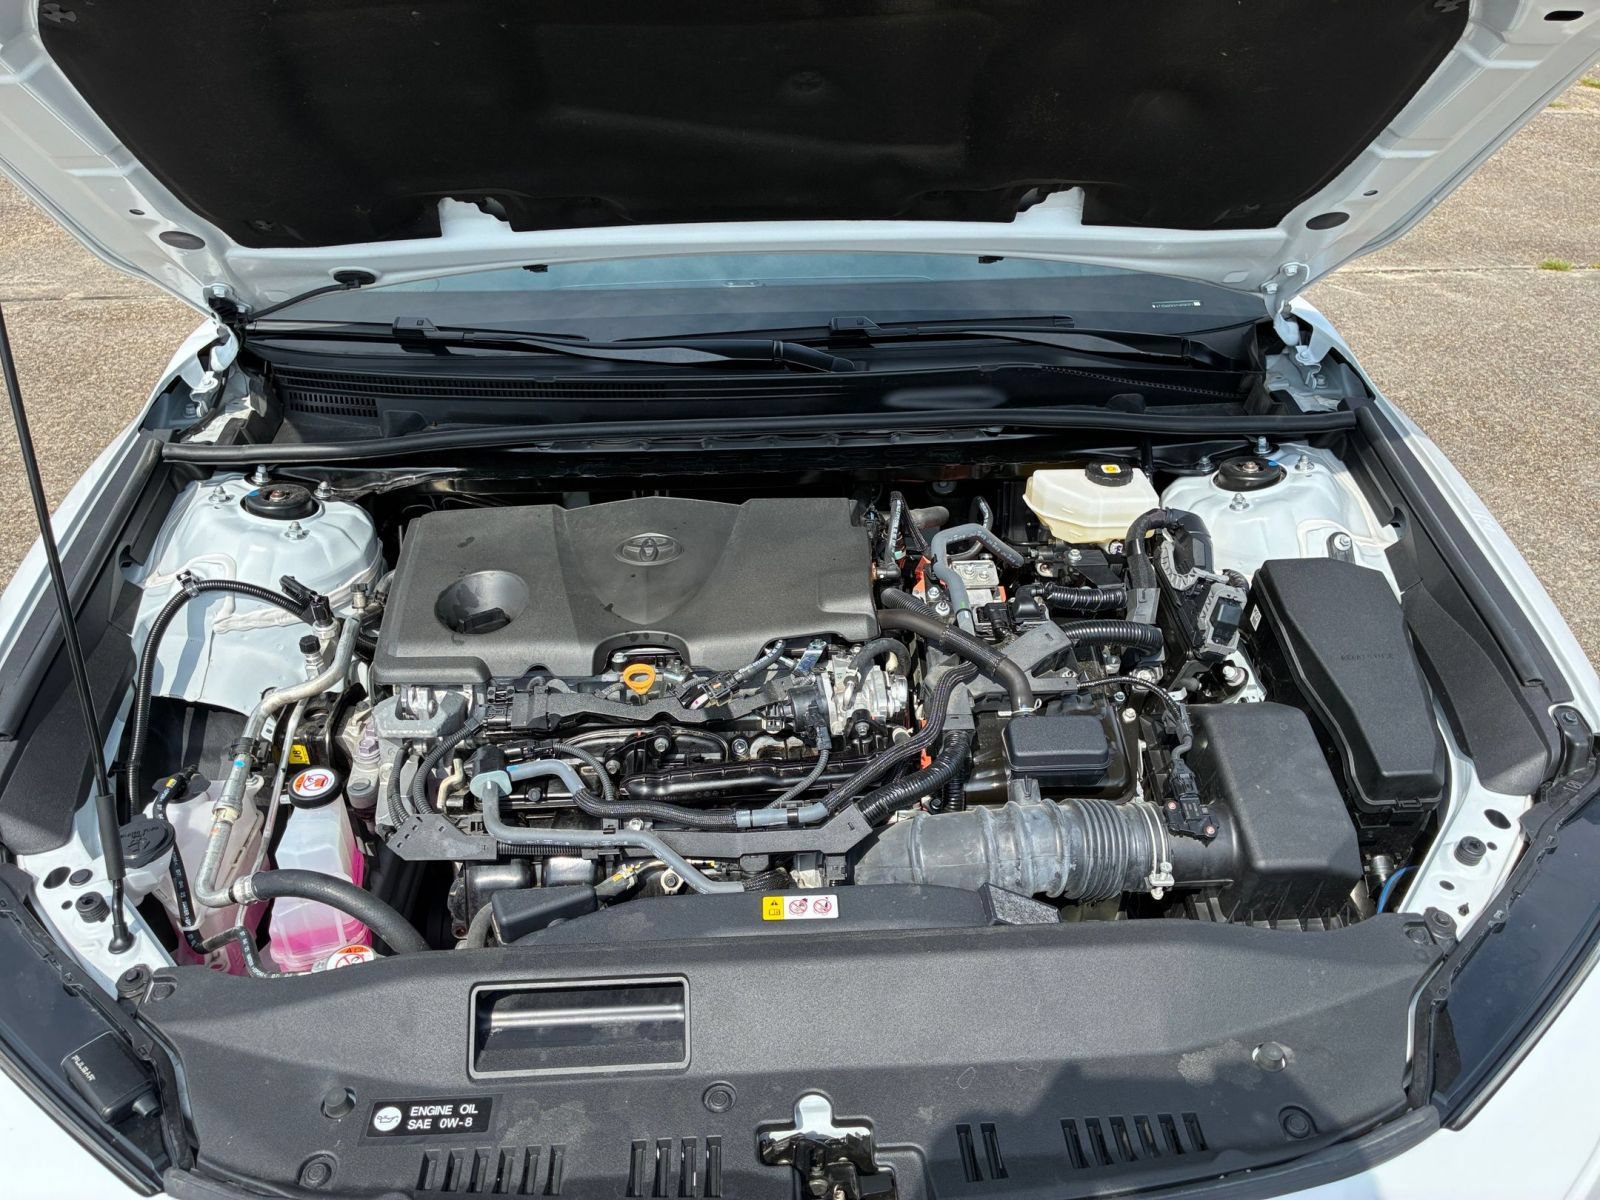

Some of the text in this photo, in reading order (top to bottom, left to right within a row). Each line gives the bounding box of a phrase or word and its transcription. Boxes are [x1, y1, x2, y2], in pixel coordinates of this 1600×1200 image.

[71, 1054, 96, 1082] PULSAR
[410, 1104, 478, 1116] ENGINE OIL
[407, 1117, 473, 1130] SAE 0W-8
